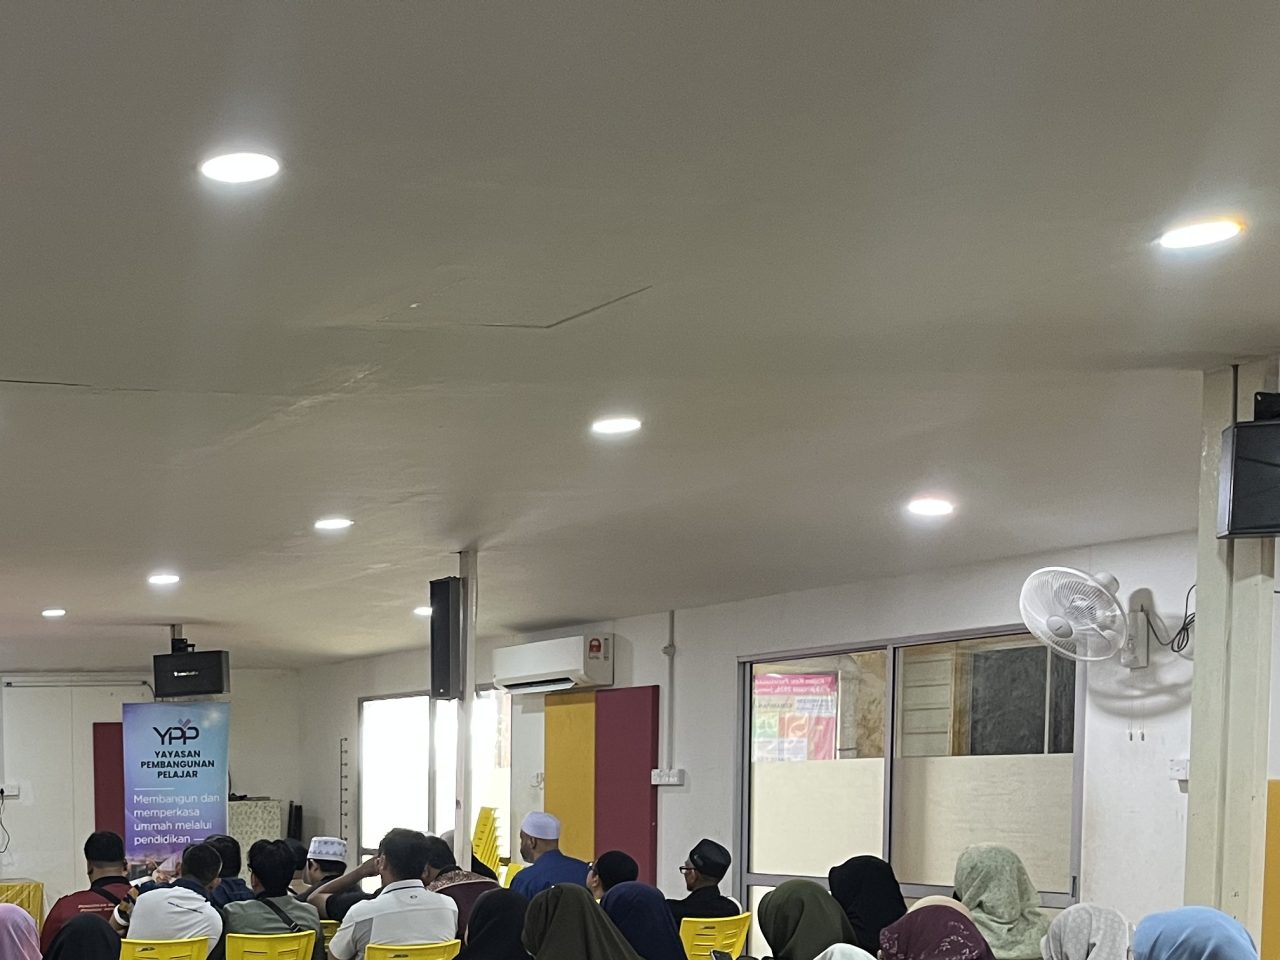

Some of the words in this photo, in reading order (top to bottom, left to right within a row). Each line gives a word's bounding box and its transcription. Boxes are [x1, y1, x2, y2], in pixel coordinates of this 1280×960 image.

[152, 724, 199, 745] YPP
[154, 750, 201, 758] YAYASAN
[140, 760, 214, 769] PEMBANGUNAN
[157, 770, 198, 779] PELAJAR
[133, 794, 198, 805] Membangun
[200, 793, 220, 803] dan
[133, 808, 200, 818] memperkasa
[134, 821, 172, 831] ummah
[175, 821, 212, 830] melalui
[134, 834, 191, 846] pendidikan
